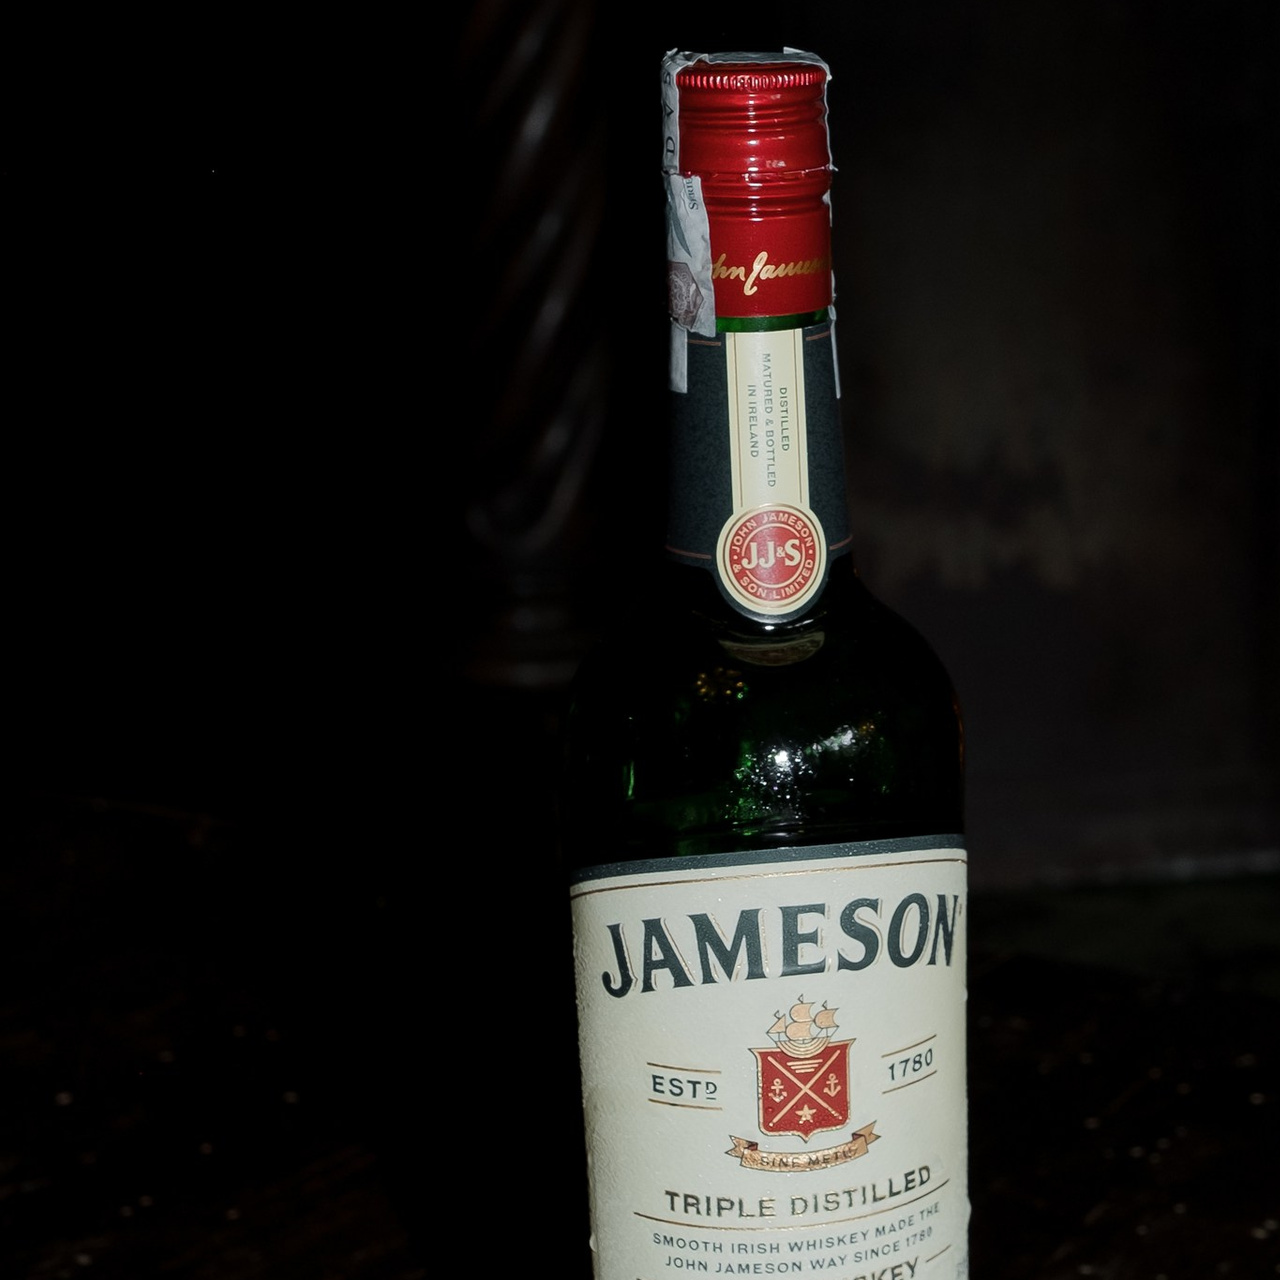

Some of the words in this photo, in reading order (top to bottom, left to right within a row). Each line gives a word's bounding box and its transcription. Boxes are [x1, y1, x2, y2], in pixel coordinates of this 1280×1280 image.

[747, 384, 757, 397] IN
[763, 353, 773, 414] MATURED
[749, 401, 759, 458] IRELAND
[780, 387, 790, 452] DISTILLED
[766, 429, 776, 487] BOTTLED
[732, 519, 757, 553] JOHN
[762, 512, 813, 547] JAMESON
[733, 564, 742, 574] &
[740, 576, 767, 598] SON
[773, 559, 814, 599] LIMITED
[601, 892, 960, 998] JAMESON
[887, 1046, 934, 1081] 1780
[665, 1190, 776, 1219] TRIPLE
[791, 1165, 931, 1217] DISTILLED
[653, 1232, 723, 1254] SMOOTH
[731, 1242, 780, 1254] IRISH
[788, 1229, 870, 1253] WHISKEY
[875, 1214, 915, 1237] MADE
[919, 1201, 940, 1221] THE
[665, 1255, 708, 1272] JOHN
[715, 1262, 801, 1275] JAMESON
[810, 1255, 848, 1270] WAY
[854, 1241, 901, 1263] SINCE
[906, 1226, 932, 1247] 1780
